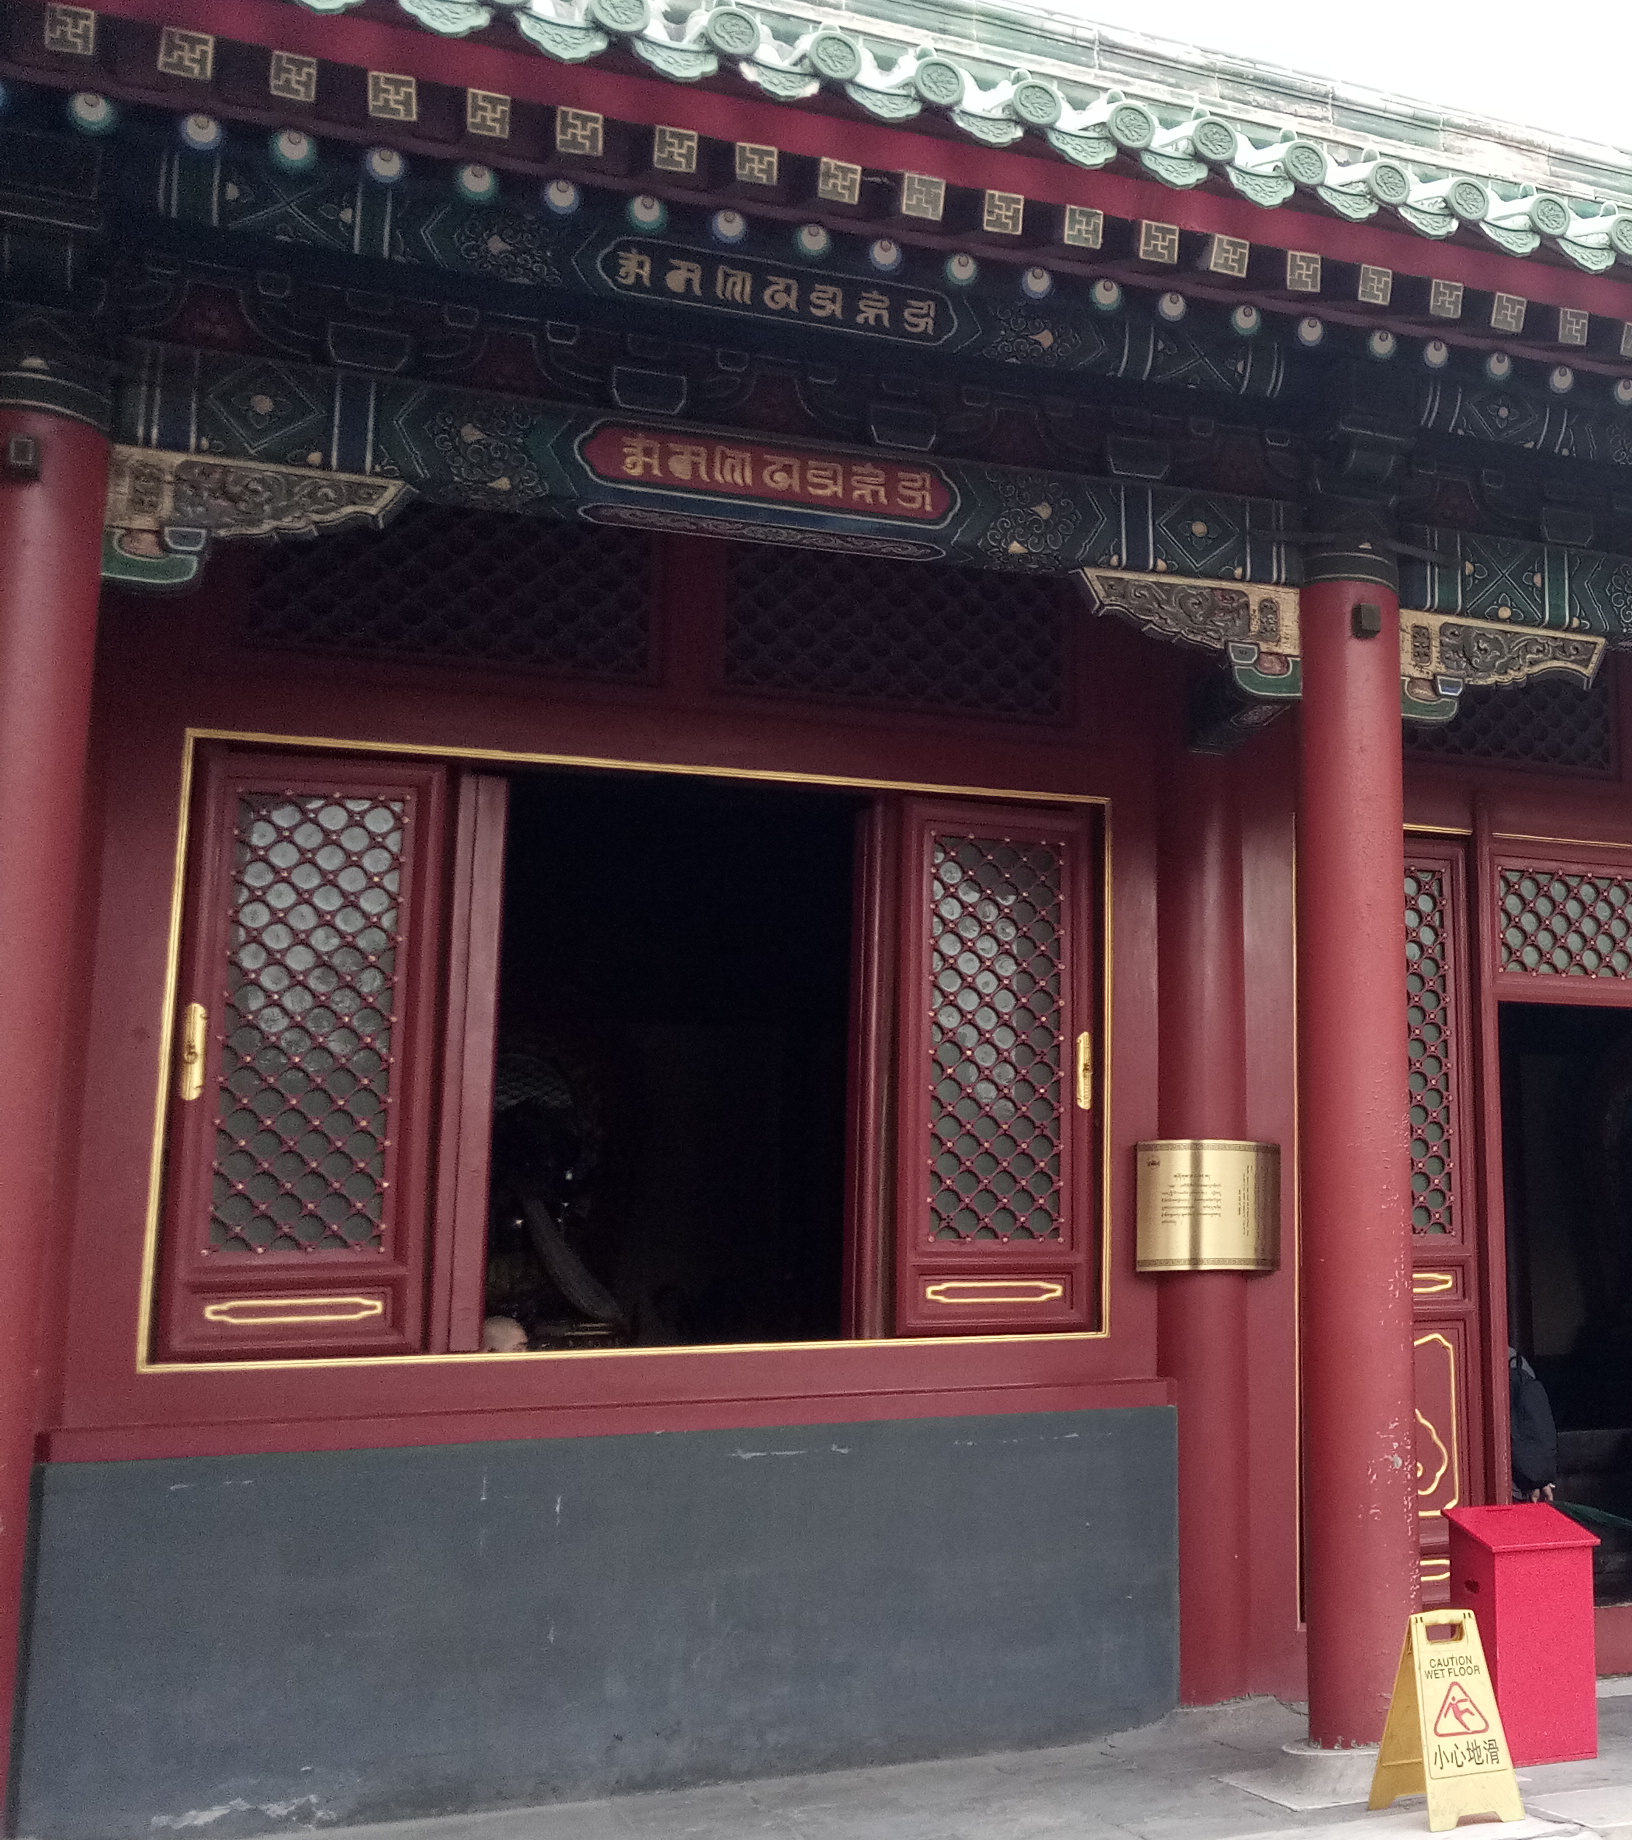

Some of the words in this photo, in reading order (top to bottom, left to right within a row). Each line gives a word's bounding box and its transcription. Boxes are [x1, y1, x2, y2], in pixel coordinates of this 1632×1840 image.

[1429, 1655, 1473, 1668] CAUTION
[1424, 1668, 1446, 1680] WET
[1447, 1664, 1481, 1678] FLOOR
[1434, 1738, 1500, 1770] 小心地滑
